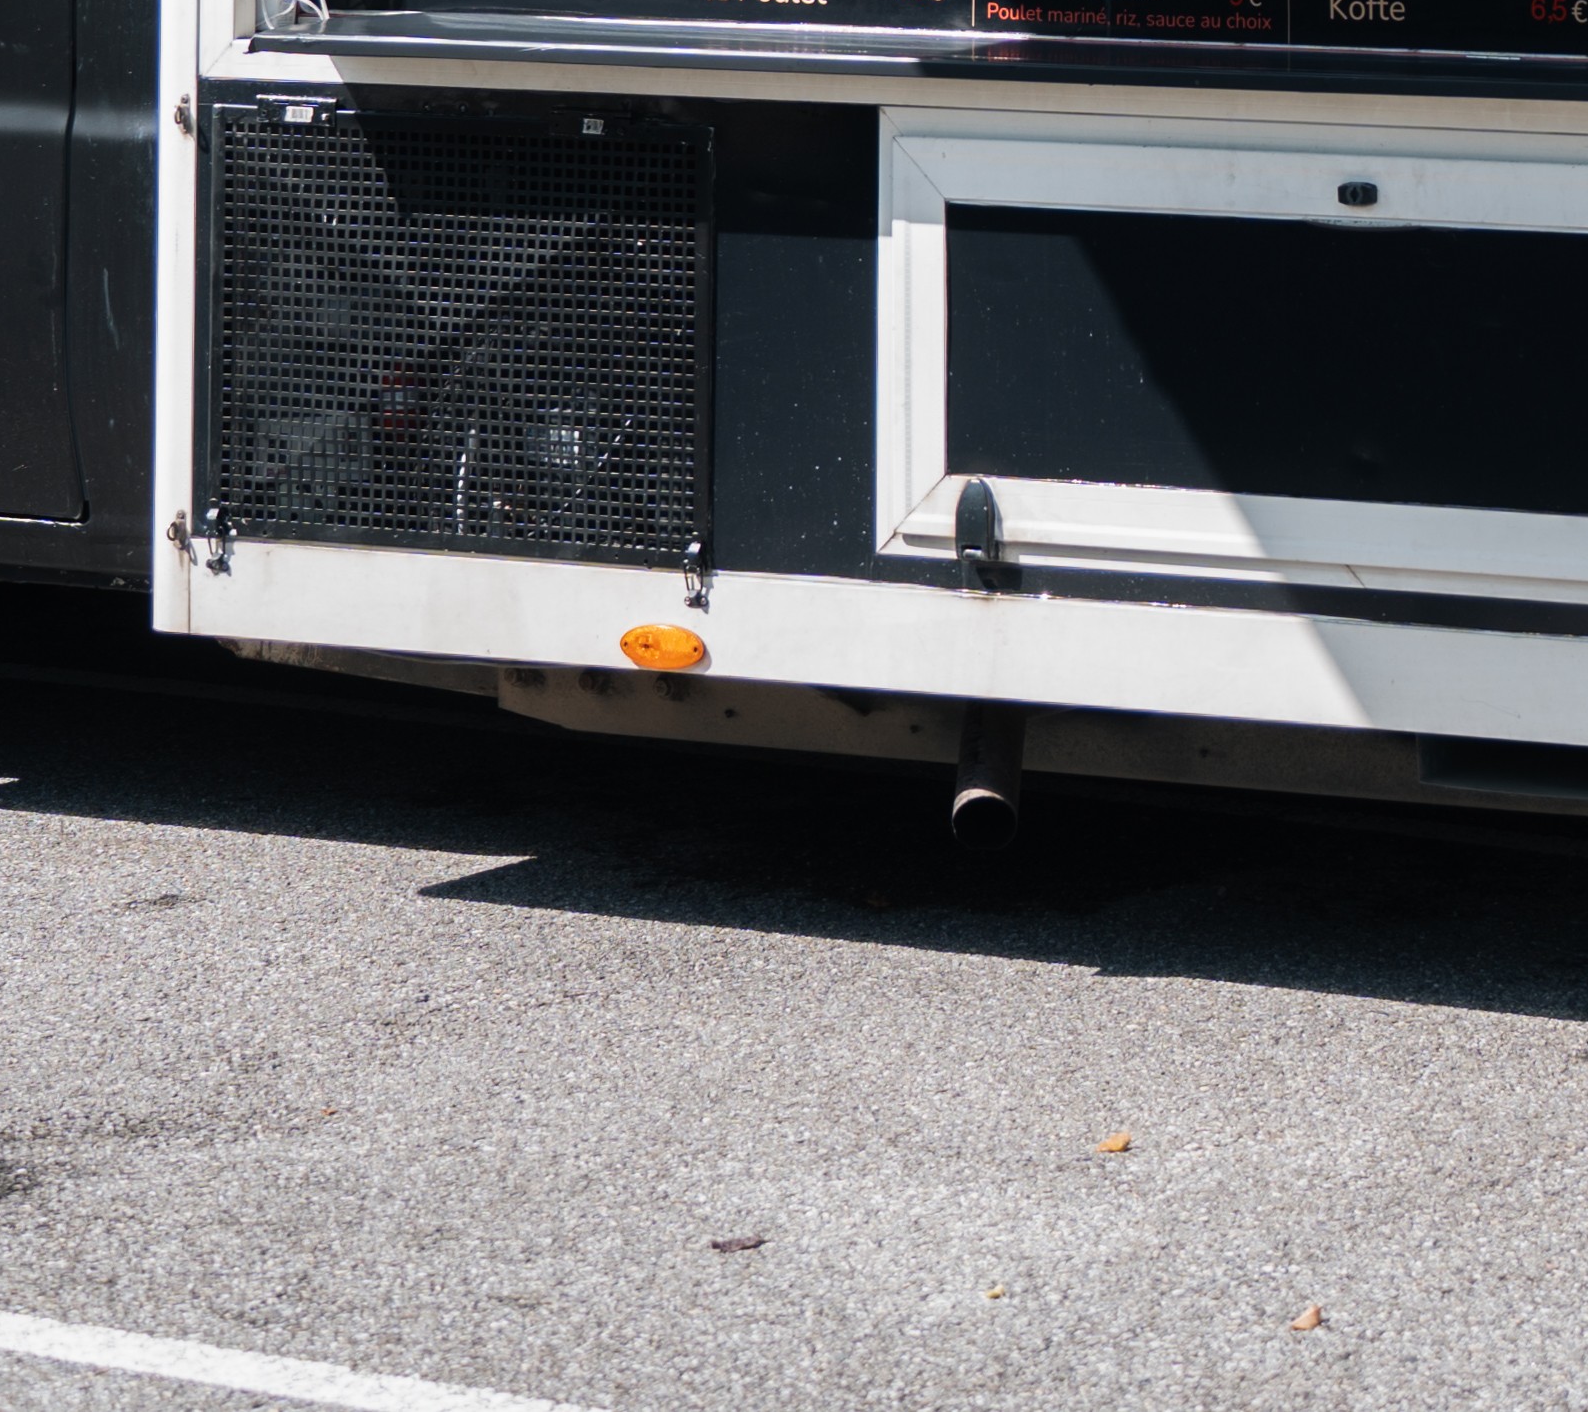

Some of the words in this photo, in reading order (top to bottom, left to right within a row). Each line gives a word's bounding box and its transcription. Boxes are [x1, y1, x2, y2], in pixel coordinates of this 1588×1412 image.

[985, 1, 1042, 22] Poulet
[1048, 7, 1110, 27] mariné,
[1116, 9, 1140, 27] riz,
[1146, 14, 1195, 28] sauce
[1201, 16, 1221, 29] au
[1226, 12, 1271, 29] choix
